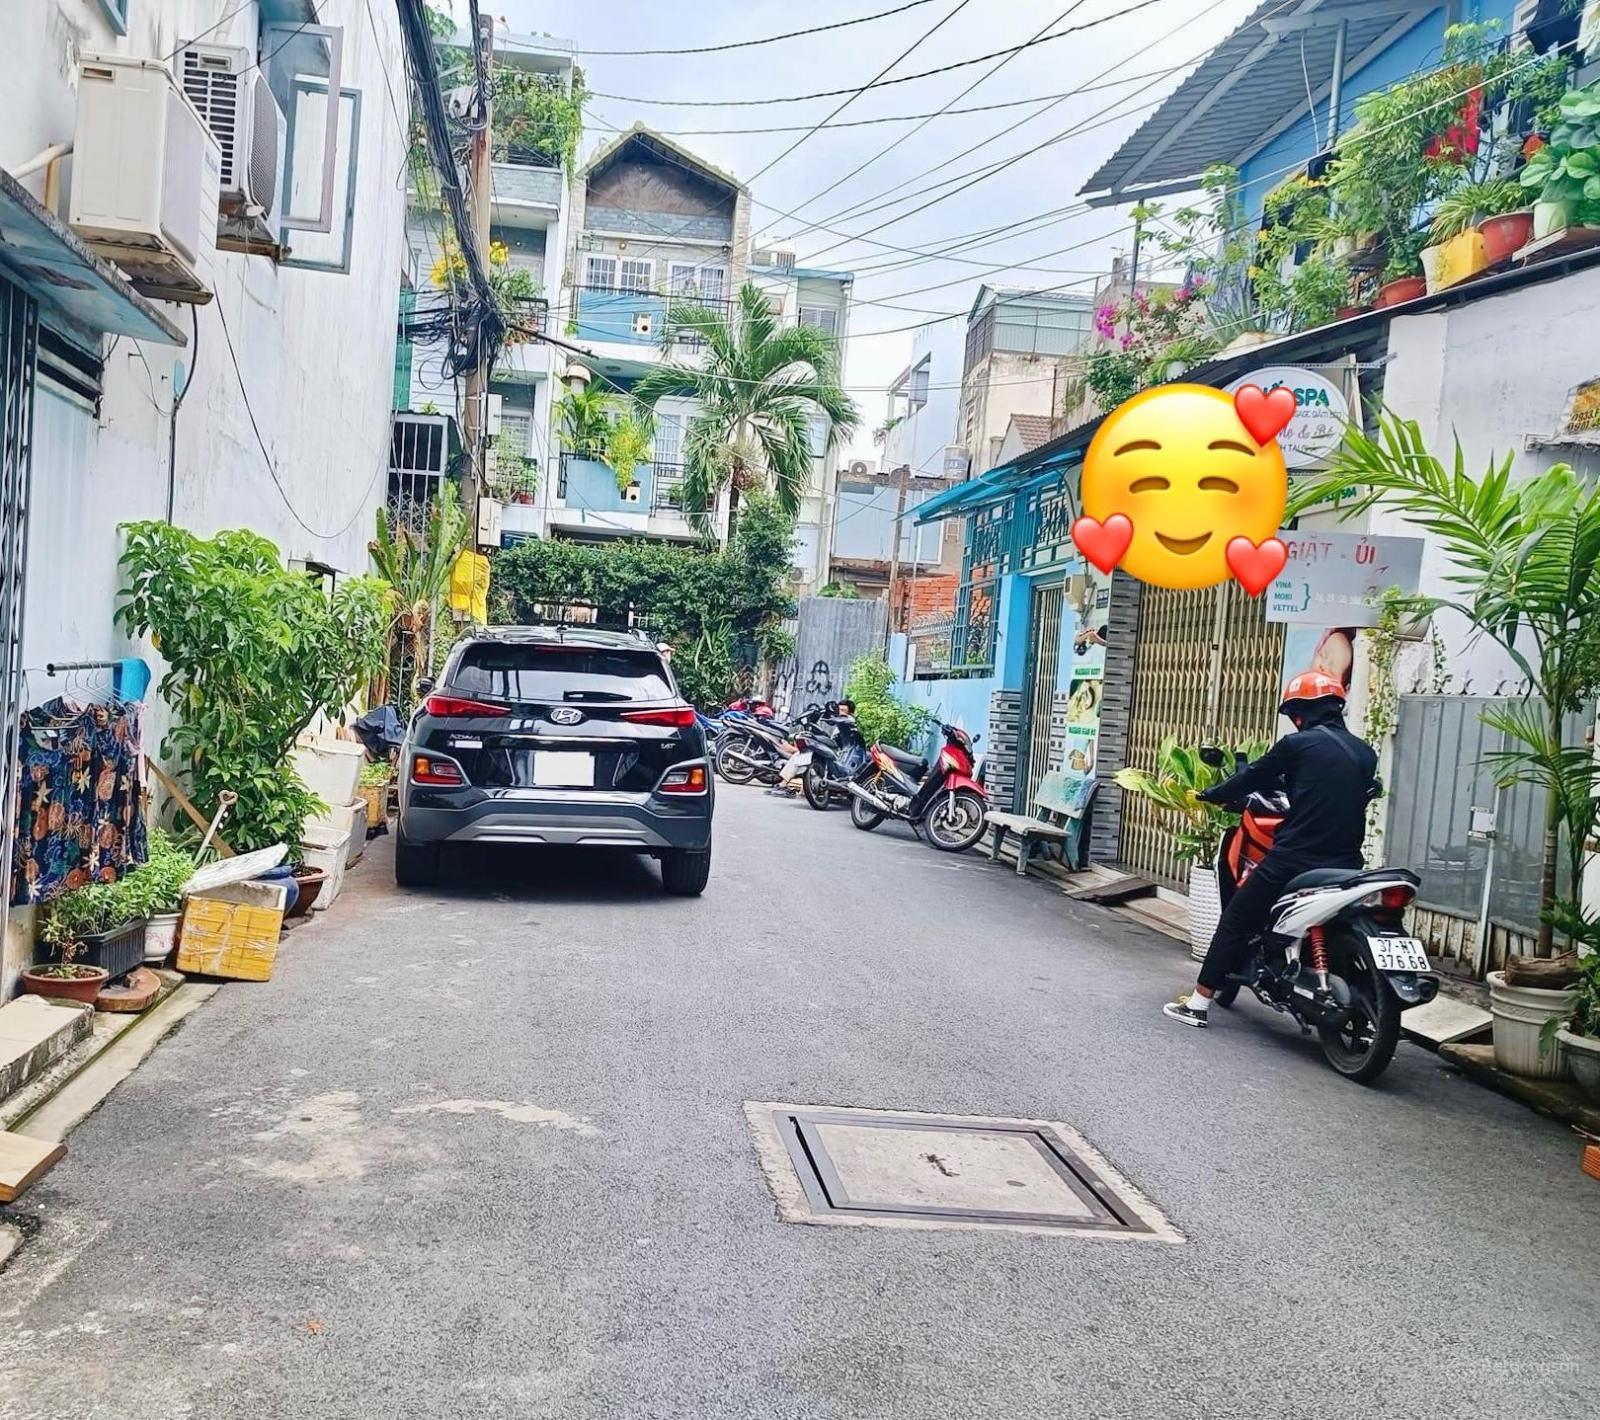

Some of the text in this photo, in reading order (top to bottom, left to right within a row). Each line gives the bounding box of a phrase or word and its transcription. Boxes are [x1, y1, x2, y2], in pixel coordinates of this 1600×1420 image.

[1294, 388, 1329, 406] SPA
[1355, 536, 1376, 565] ỦI
[1378, 954, 1427, 970] 376.68
